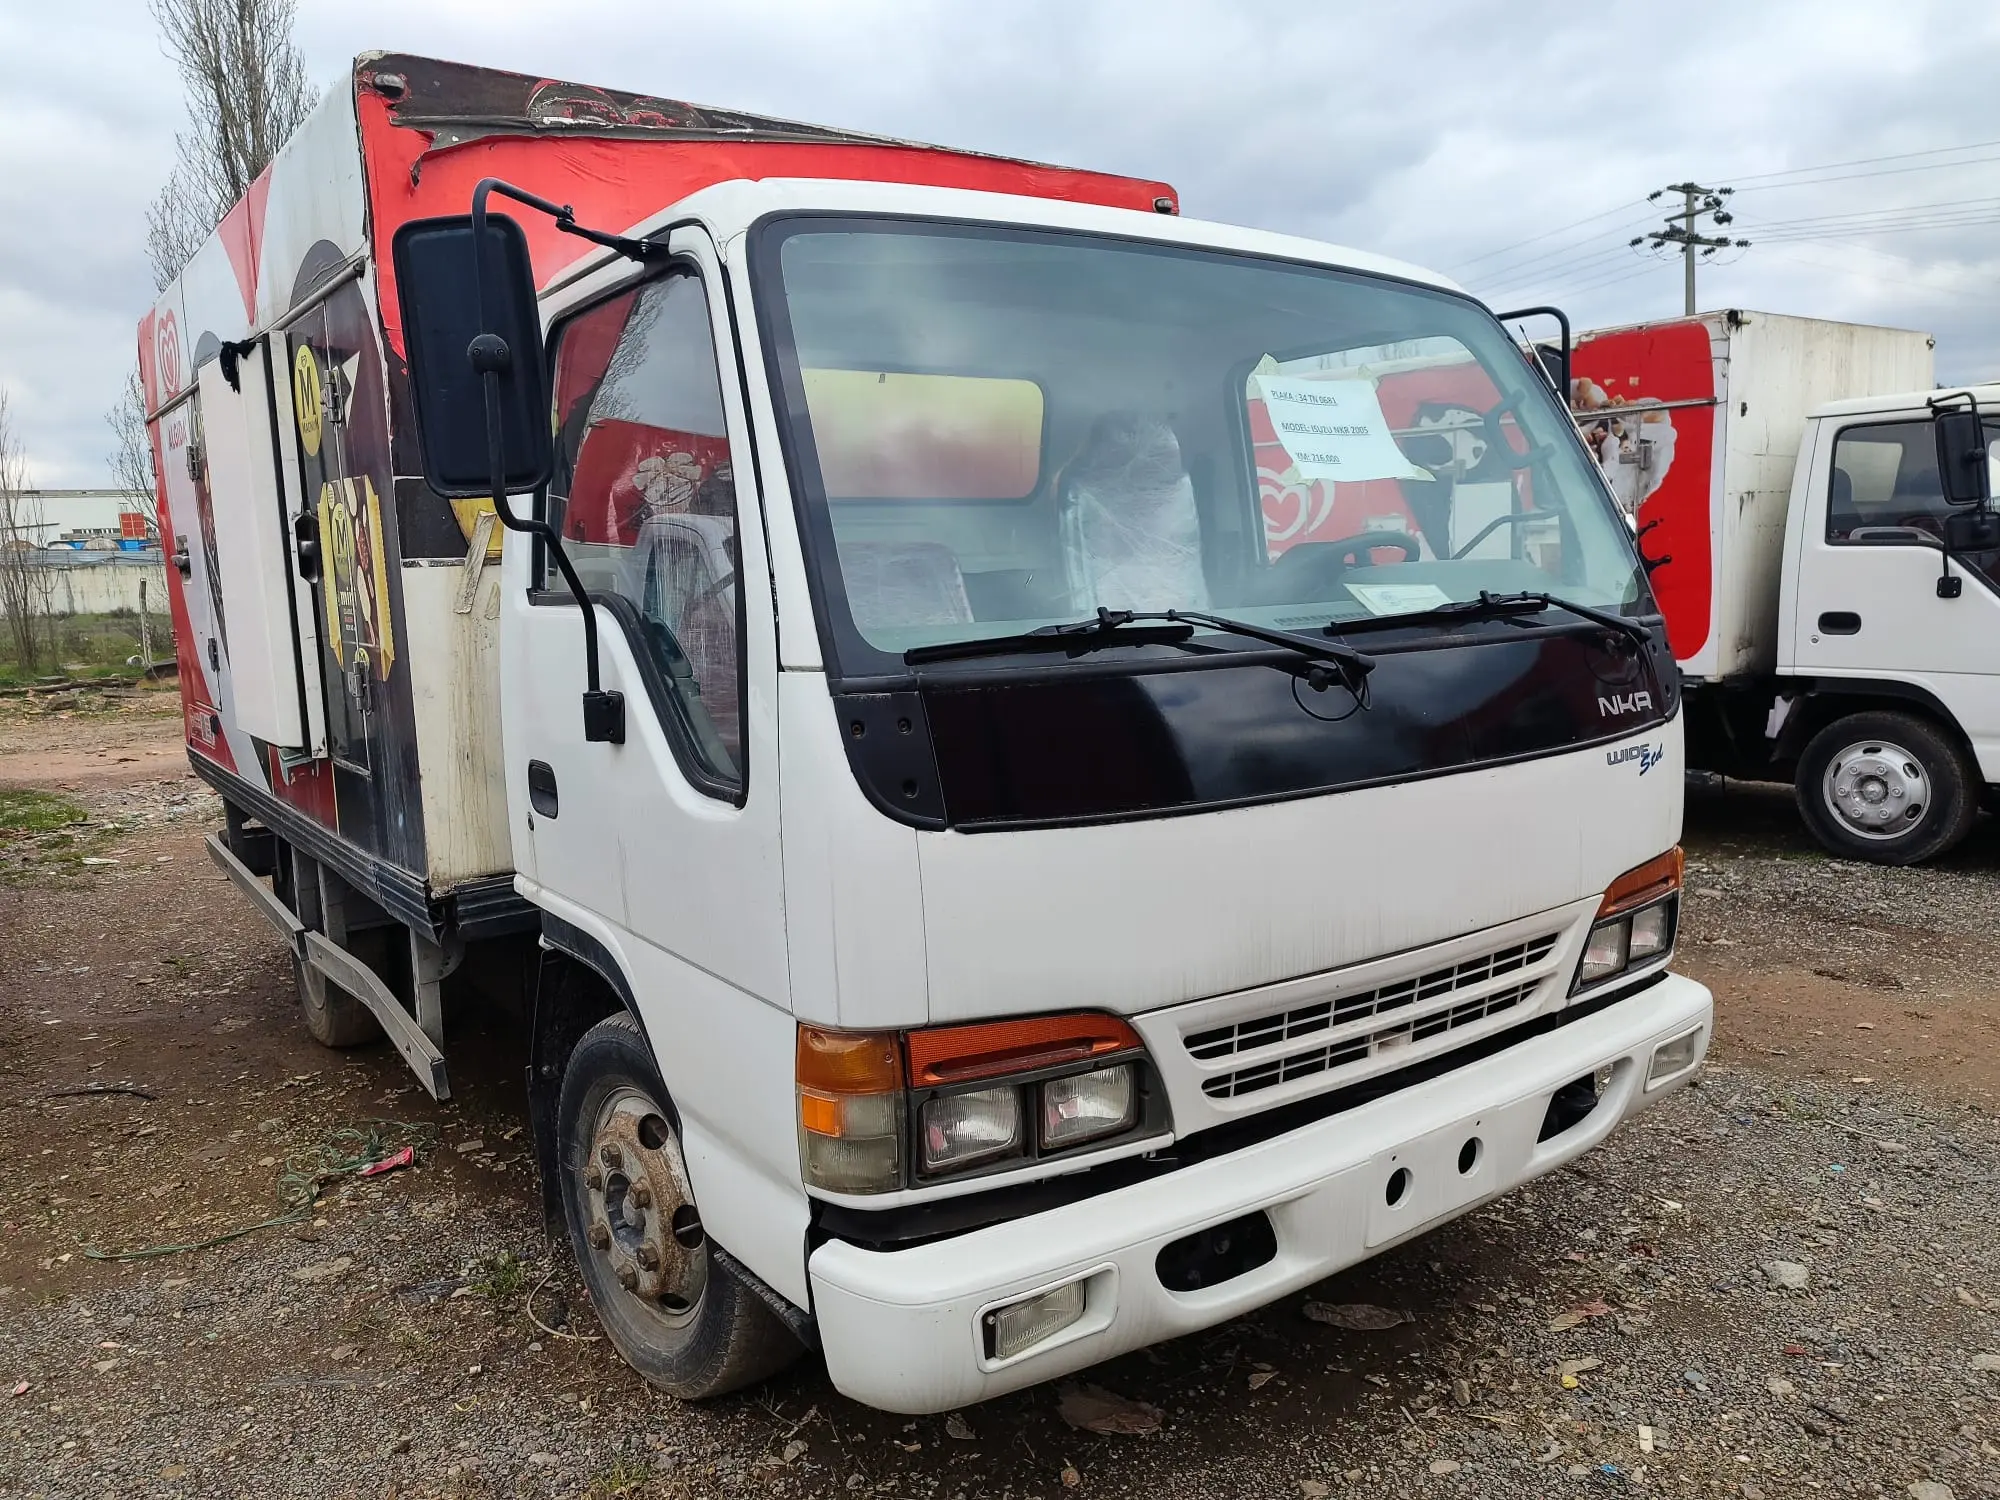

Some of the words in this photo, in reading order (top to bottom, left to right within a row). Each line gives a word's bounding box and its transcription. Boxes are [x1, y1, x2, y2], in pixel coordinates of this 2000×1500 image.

[298, 366, 316, 419] M
[1271, 390, 1293, 401] PLAKA
[1299, 393, 1307, 402] 34
[1308, 394, 1319, 403] TN
[1281, 422, 1310, 432] MODEL:
[1311, 424, 1333, 434] ISUZU
[1333, 425, 1350, 434] NKR
[1351, 426, 1369, 434] 2005
[1597, 690, 1653, 717] NKR
[1606, 743, 1650, 766] WIDE
